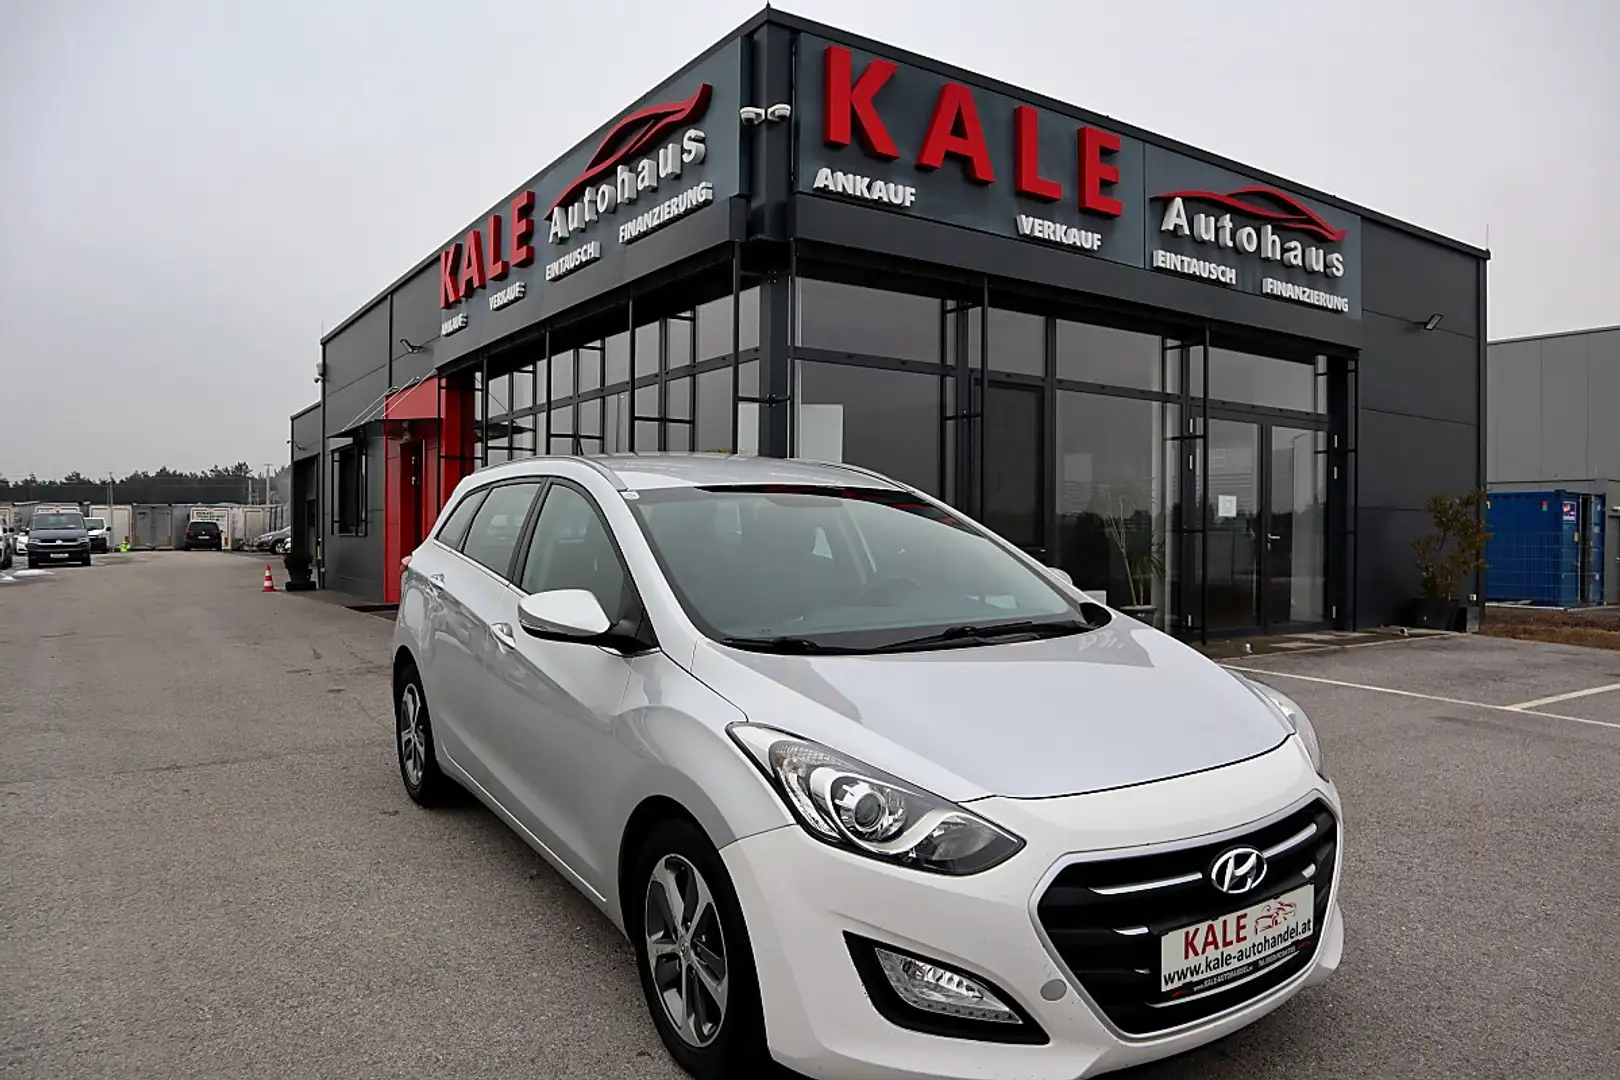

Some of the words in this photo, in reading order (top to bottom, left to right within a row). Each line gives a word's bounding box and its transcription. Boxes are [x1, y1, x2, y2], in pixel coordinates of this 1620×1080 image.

[824, 44, 1123, 217] KALE
[548, 128, 706, 243] Autohaus
[618, 181, 713, 244] FINANZIERUNG
[813, 167, 916, 207] ANKAUF
[440, 190, 535, 309] KALE
[1016, 214, 1102, 251] VERKAUF
[1161, 197, 1344, 277] Autohaus
[545, 240, 601, 281] EINTAUSCH
[1152, 250, 1237, 285] EINTAUSCH
[1262, 277, 1349, 313] FINANZIERUNG
[1163, 918, 1312, 986] www.kale-autohandel.at
[1184, 913, 1248, 960] KALE
